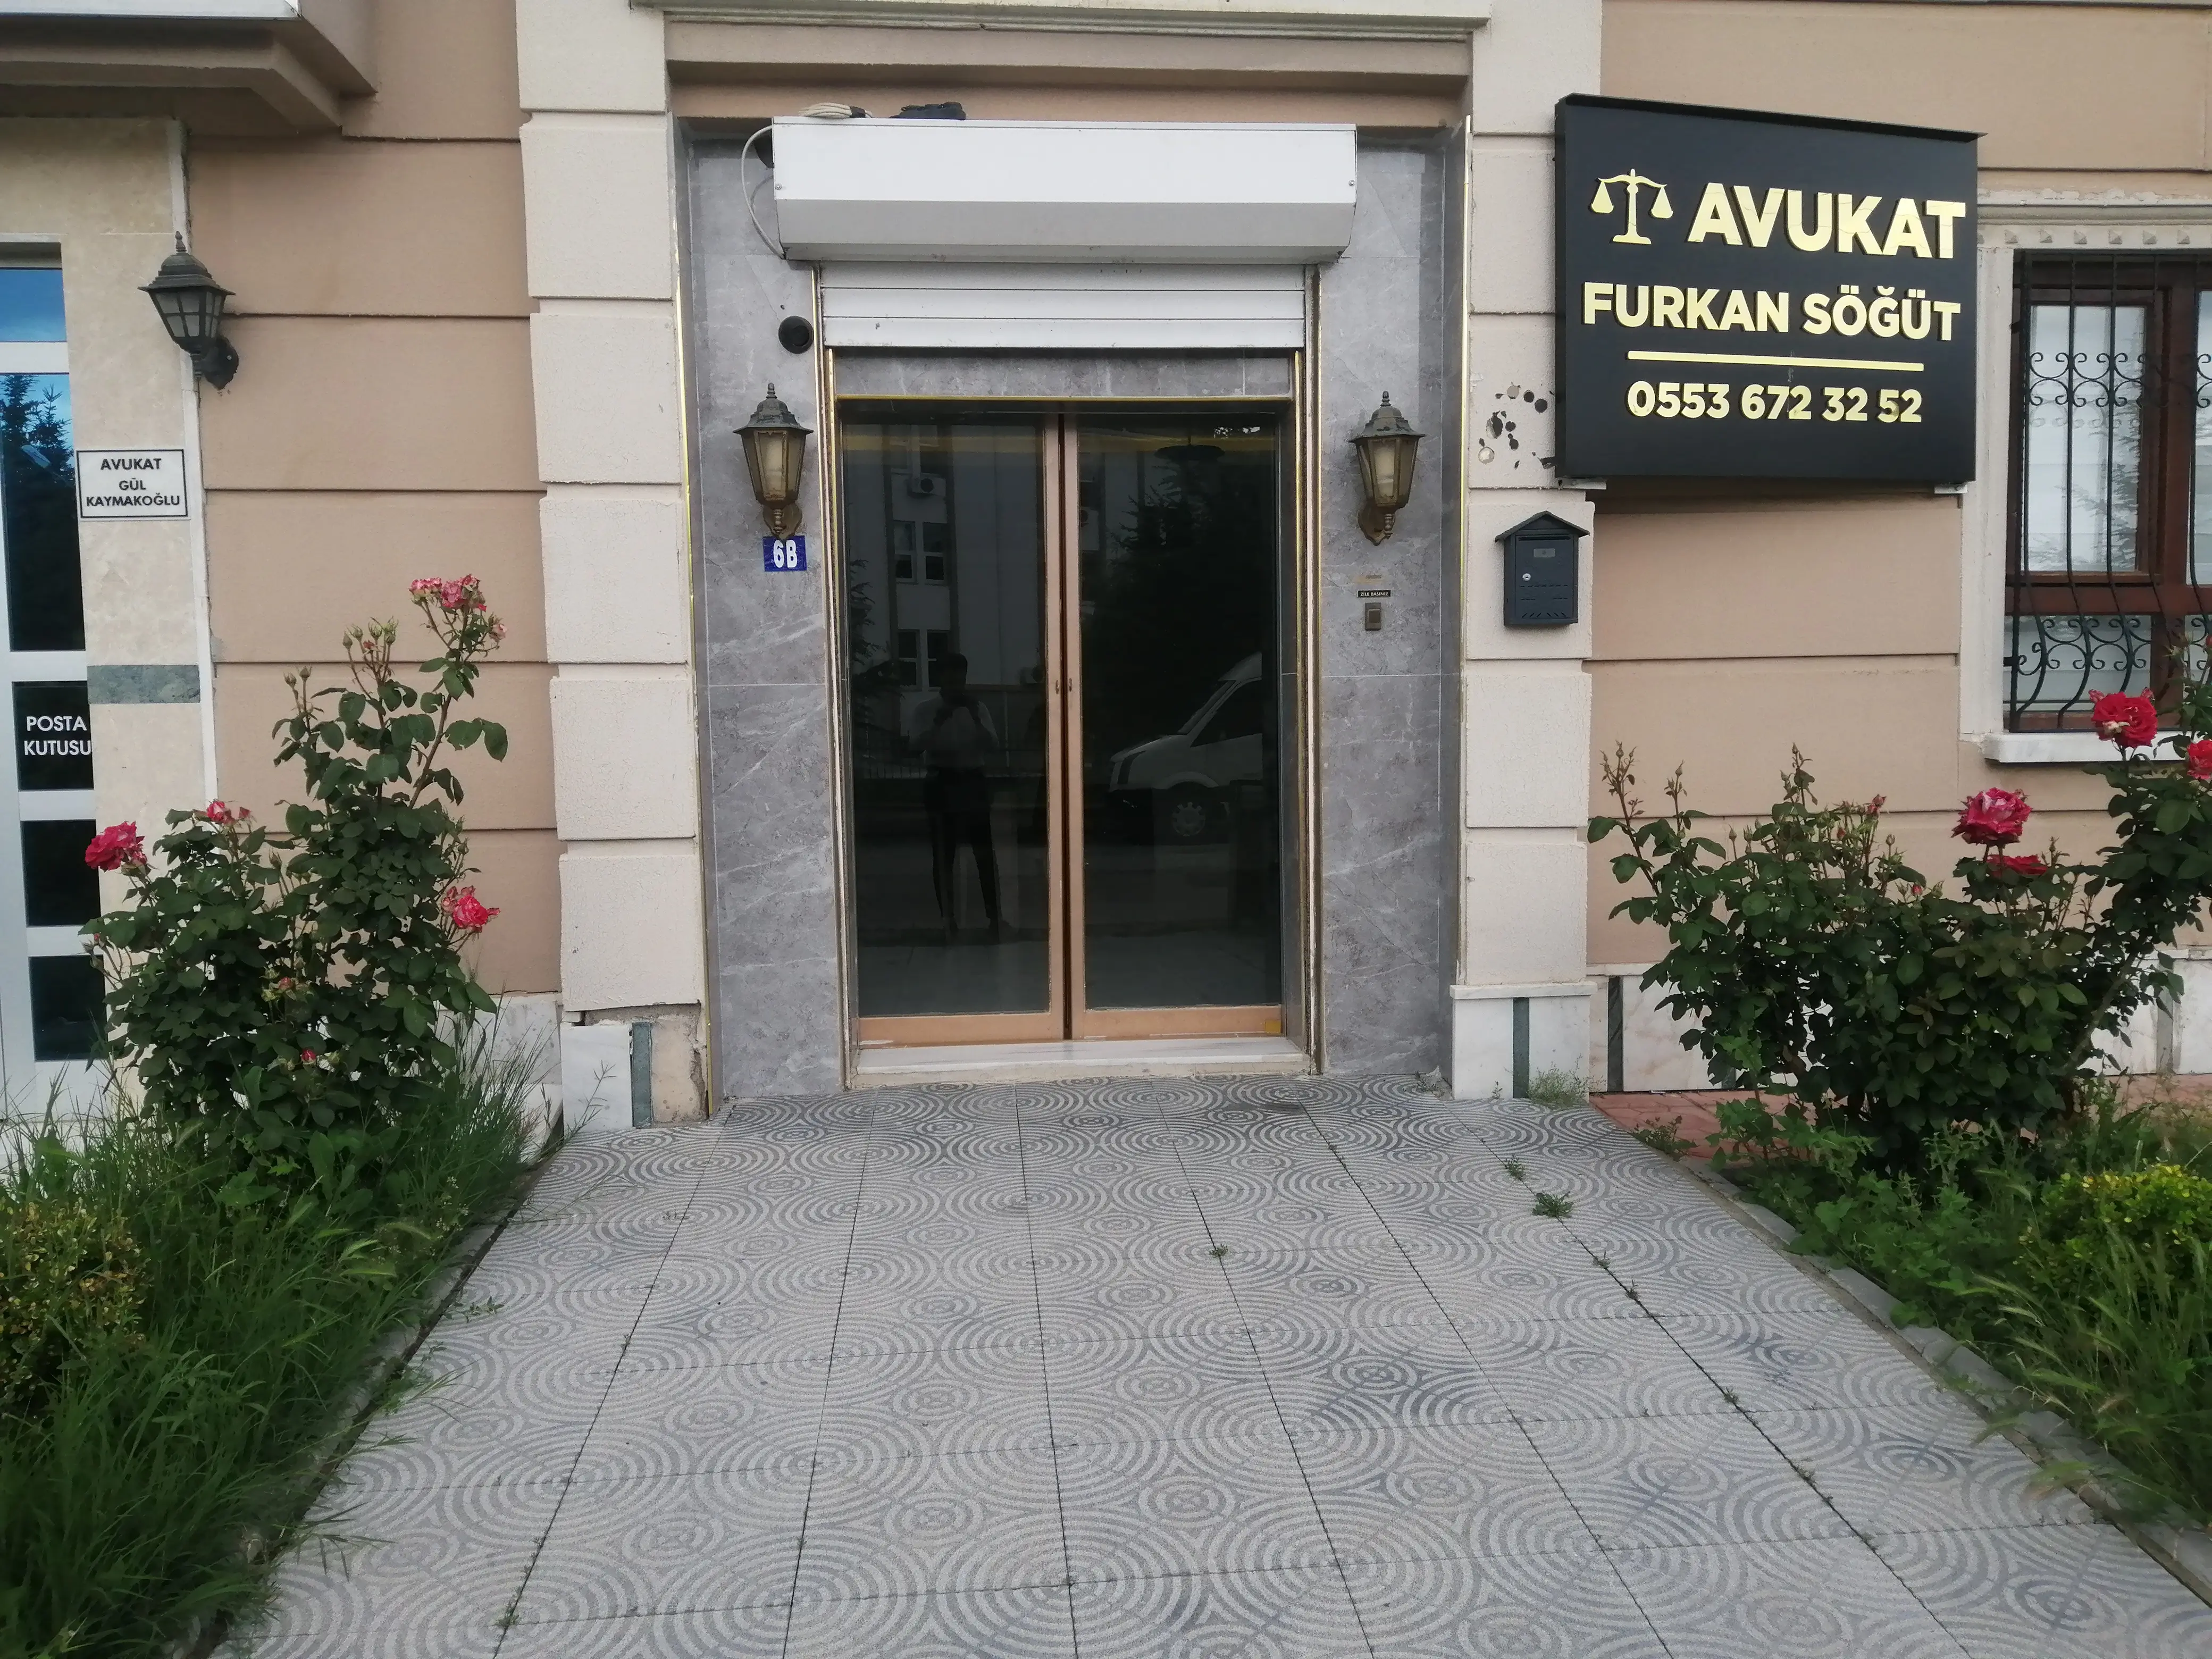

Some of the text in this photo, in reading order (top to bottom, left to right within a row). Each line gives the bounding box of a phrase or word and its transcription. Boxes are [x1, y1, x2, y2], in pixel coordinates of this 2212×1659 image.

[1688, 182, 1966, 259] AVUKAT
[1585, 282, 1961, 341] FURKAN SÖĞÜT
[1628, 381, 1922, 423] 0553 672 32 52
[100, 458, 162, 471] AVUKAT
[119, 477, 147, 491] GÜL
[87, 492, 180, 507] KAYMAKOĞLU
[773, 540, 798, 568] 6B
[27, 716, 87, 732] POSTA
[24, 740, 91, 756] KUTUSU
